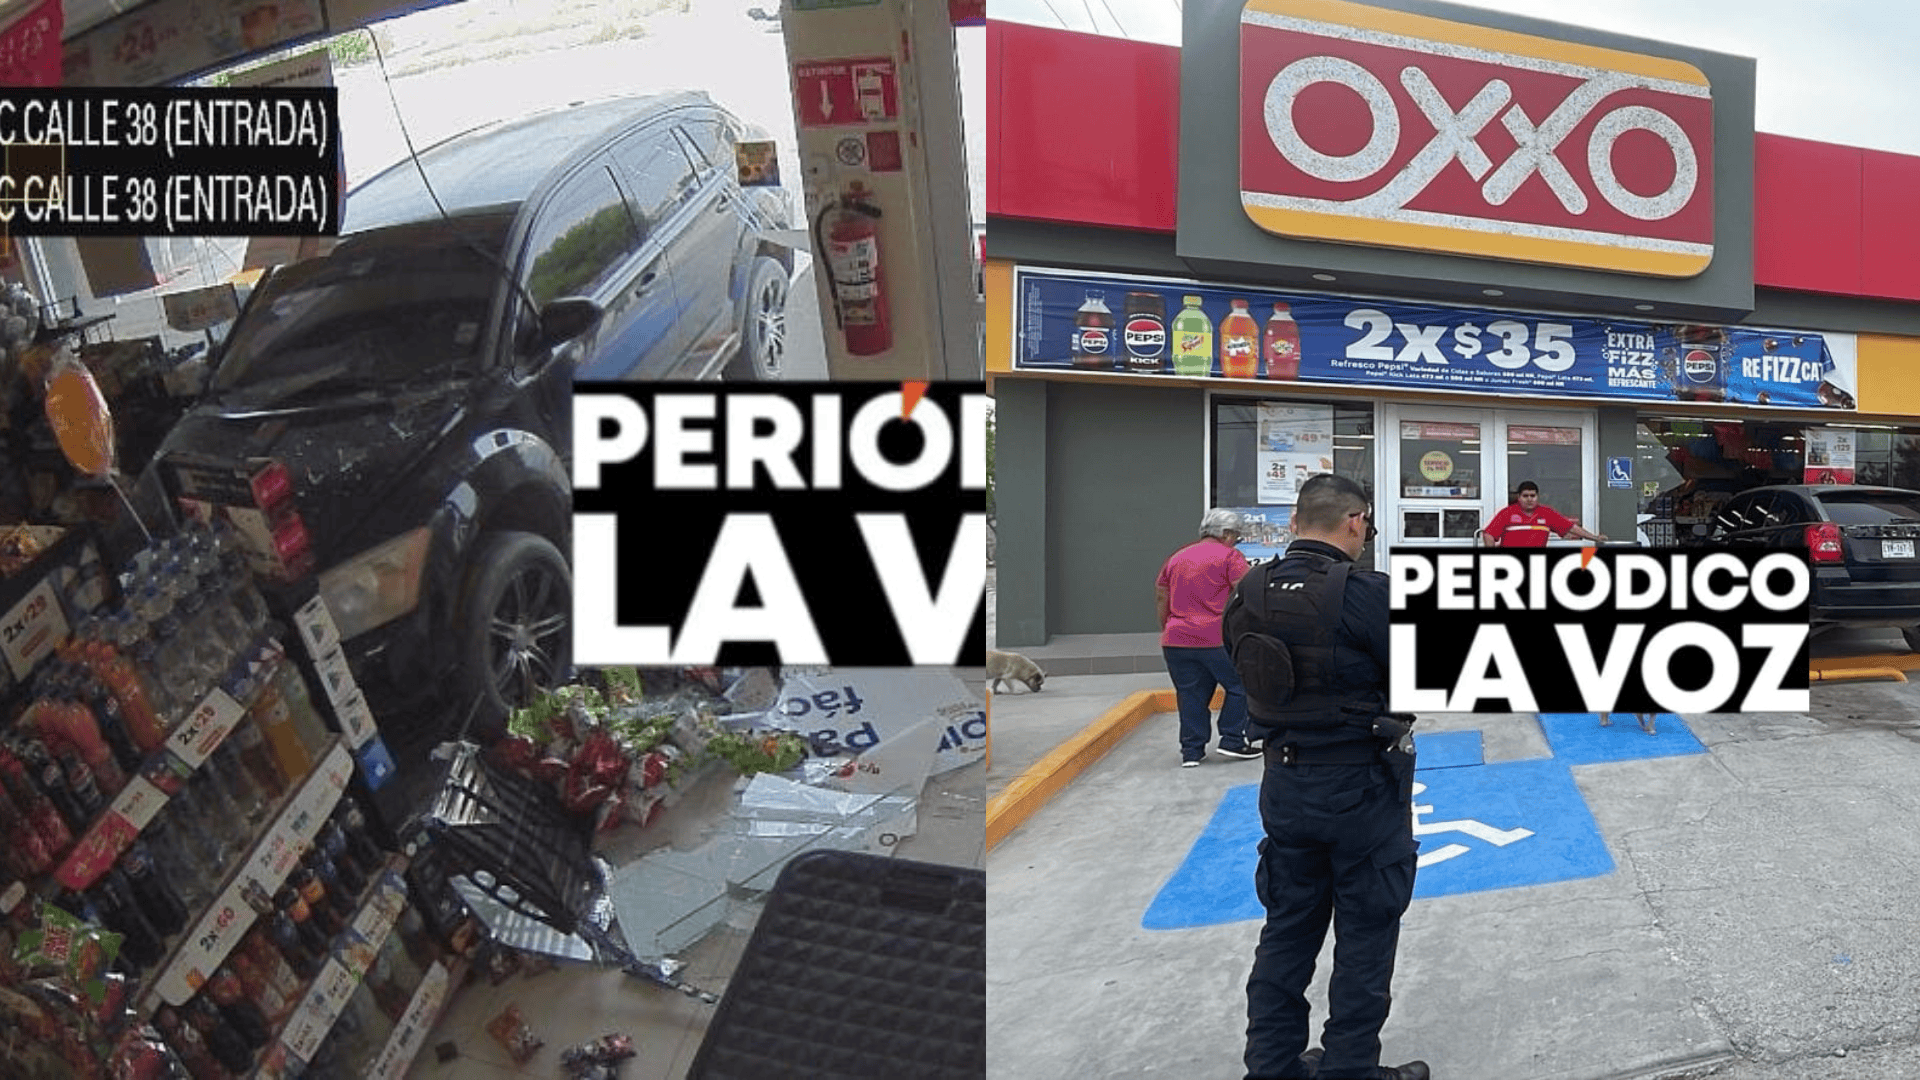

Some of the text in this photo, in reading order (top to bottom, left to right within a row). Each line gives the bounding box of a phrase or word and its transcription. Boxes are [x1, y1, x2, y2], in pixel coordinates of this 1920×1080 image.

[1263, 56, 1697, 222] OXXO
[1126, 332, 1164, 342] PEPSI
[1344, 309, 1576, 372] 2x$35
[1608, 332, 1655, 350] EXTRA
[1130, 356, 1160, 365] KICK
[1331, 359, 1375, 369] Refresco
[1686, 362, 1715, 371] PEPSI
[1608, 365, 1656, 379] MÁS
[1608, 377, 1657, 389] REFRESCANTE
[803, 721, 880, 758] pa
